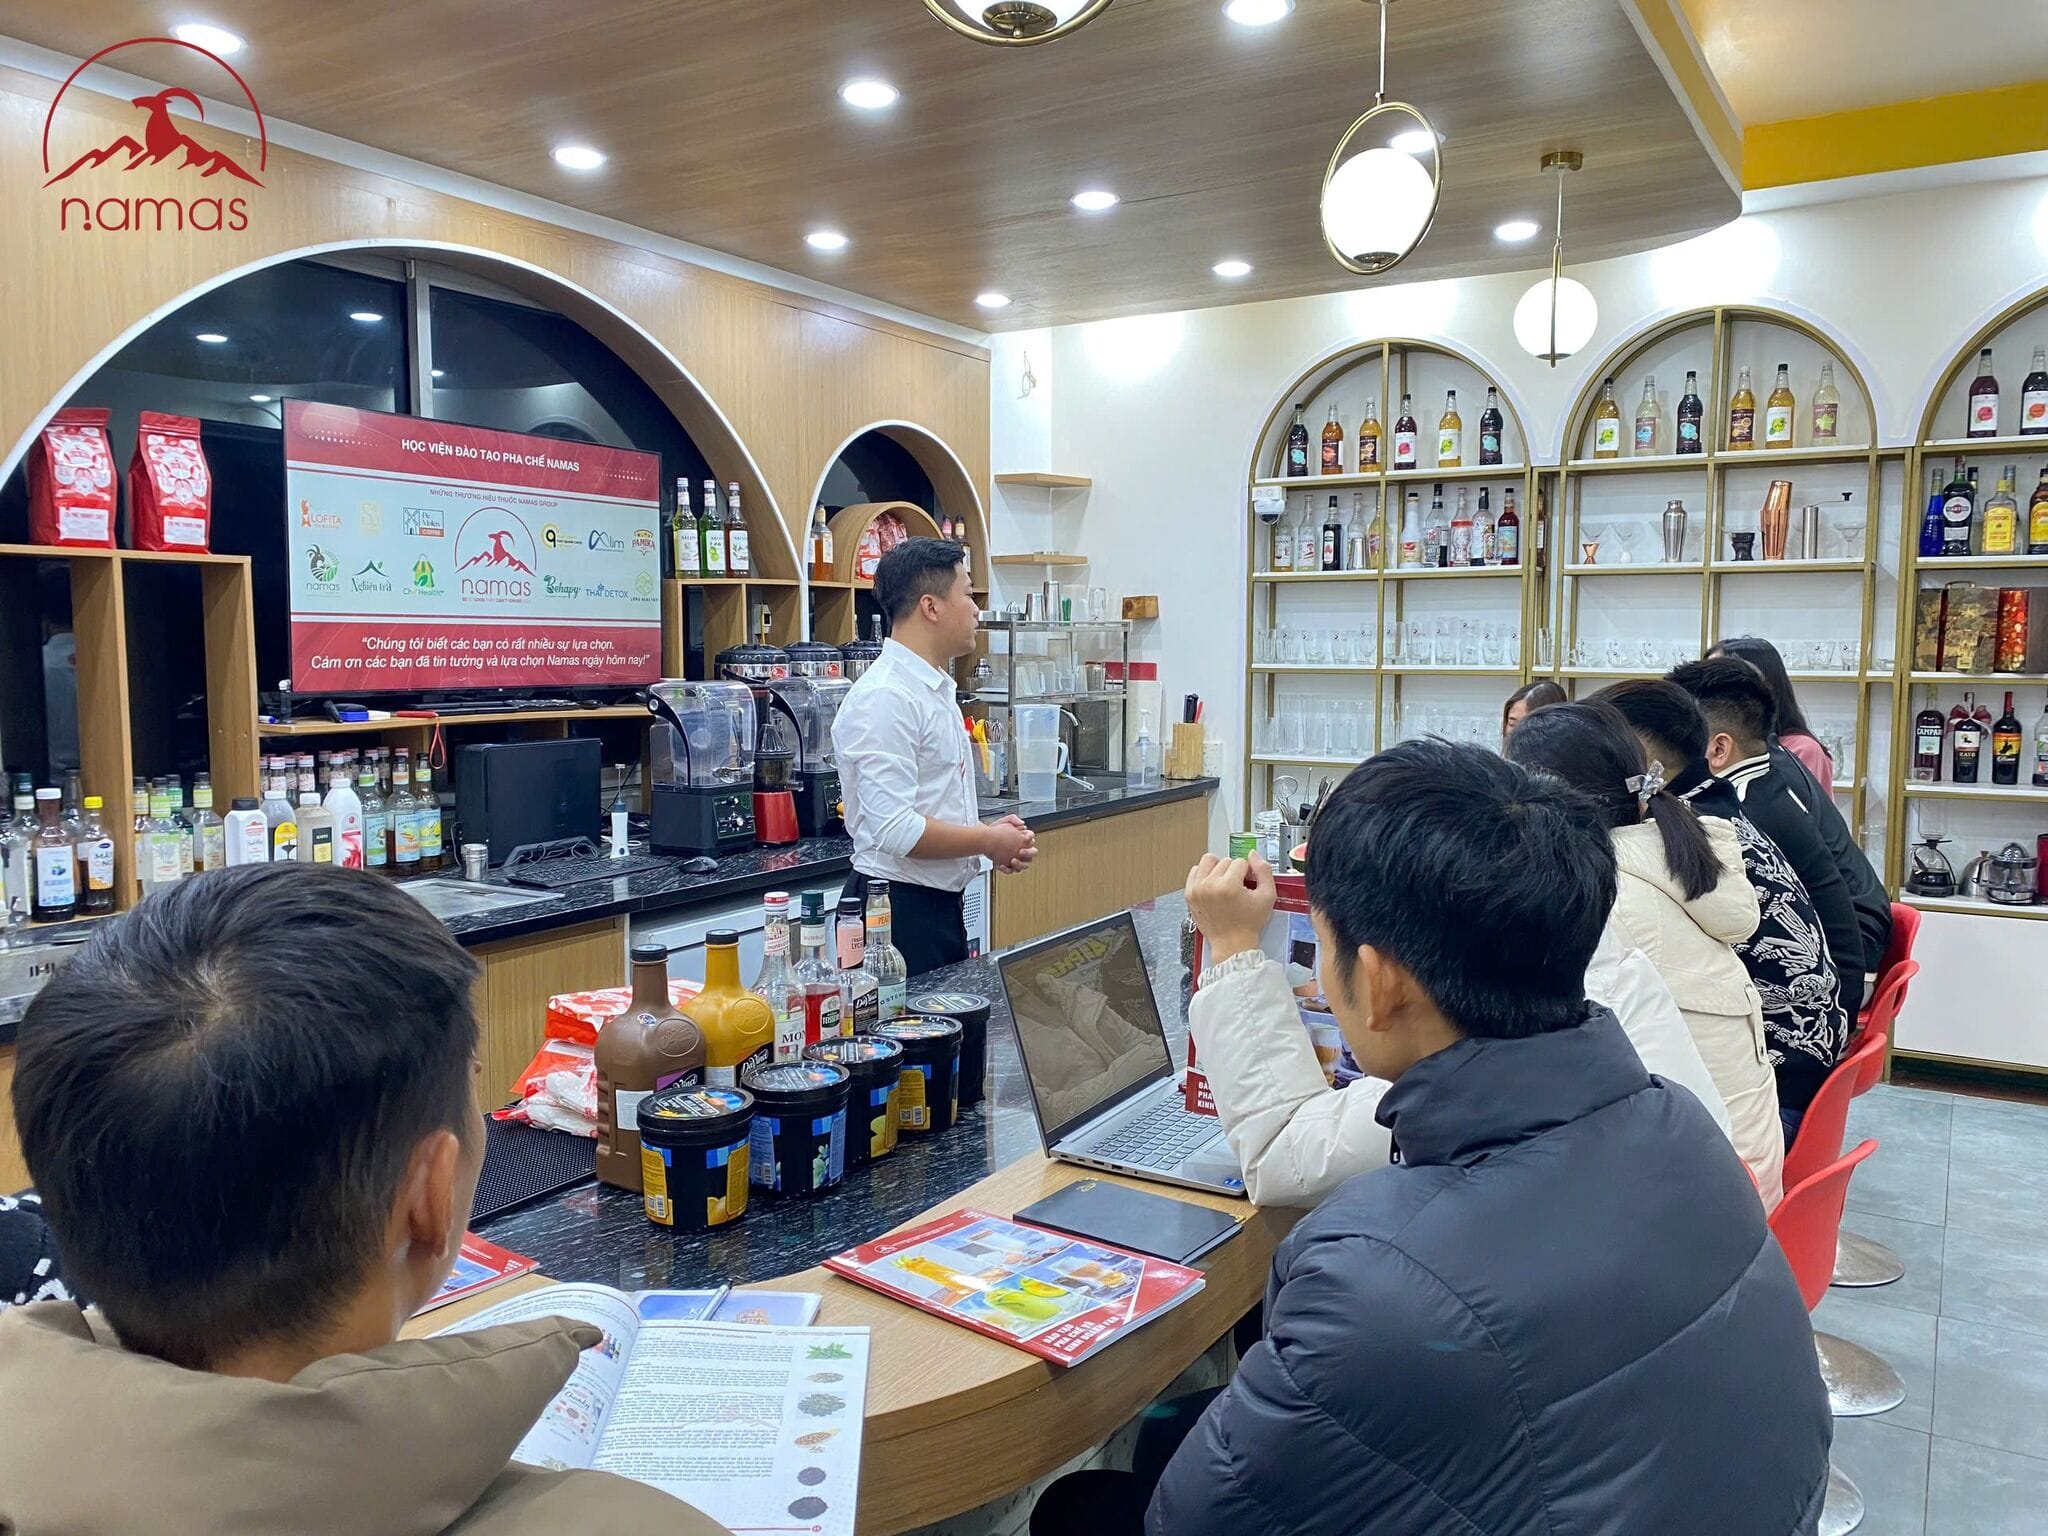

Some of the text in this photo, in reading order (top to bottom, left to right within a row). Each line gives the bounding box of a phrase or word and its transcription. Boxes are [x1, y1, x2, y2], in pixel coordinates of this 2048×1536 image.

[401, 439, 580, 472] HỌC VIỆN ĐÀO TẠO PHA CHẾ NAMAS
[409, 638, 424, 650] tôi
[427, 636, 448, 650] biết
[450, 638, 470, 650] các
[473, 638, 493, 652] bạn
[496, 638, 509, 650] có
[511, 637, 525, 650] rất
[528, 637, 555, 650] nhiều
[557, 640, 570, 651] sự
[572, 639, 588, 651] lựa
[590, 639, 615, 651] chọn.
[311, 655, 341, 669] Cảm
[344, 657, 362, 668] ơn
[365, 655, 386, 668] các
[390, 655, 412, 670] bạn
[415, 655, 430, 668] đã
[433, 655, 447, 667] tin
[450, 655, 483, 669] tưởng
[486, 656, 498, 666] và
[500, 655, 518, 667] lựa
[519, 655, 544, 668] chọn
[547, 655, 580, 666] Namas
[582, 655, 604, 668] ngày
[606, 654, 626, 665] hôm
